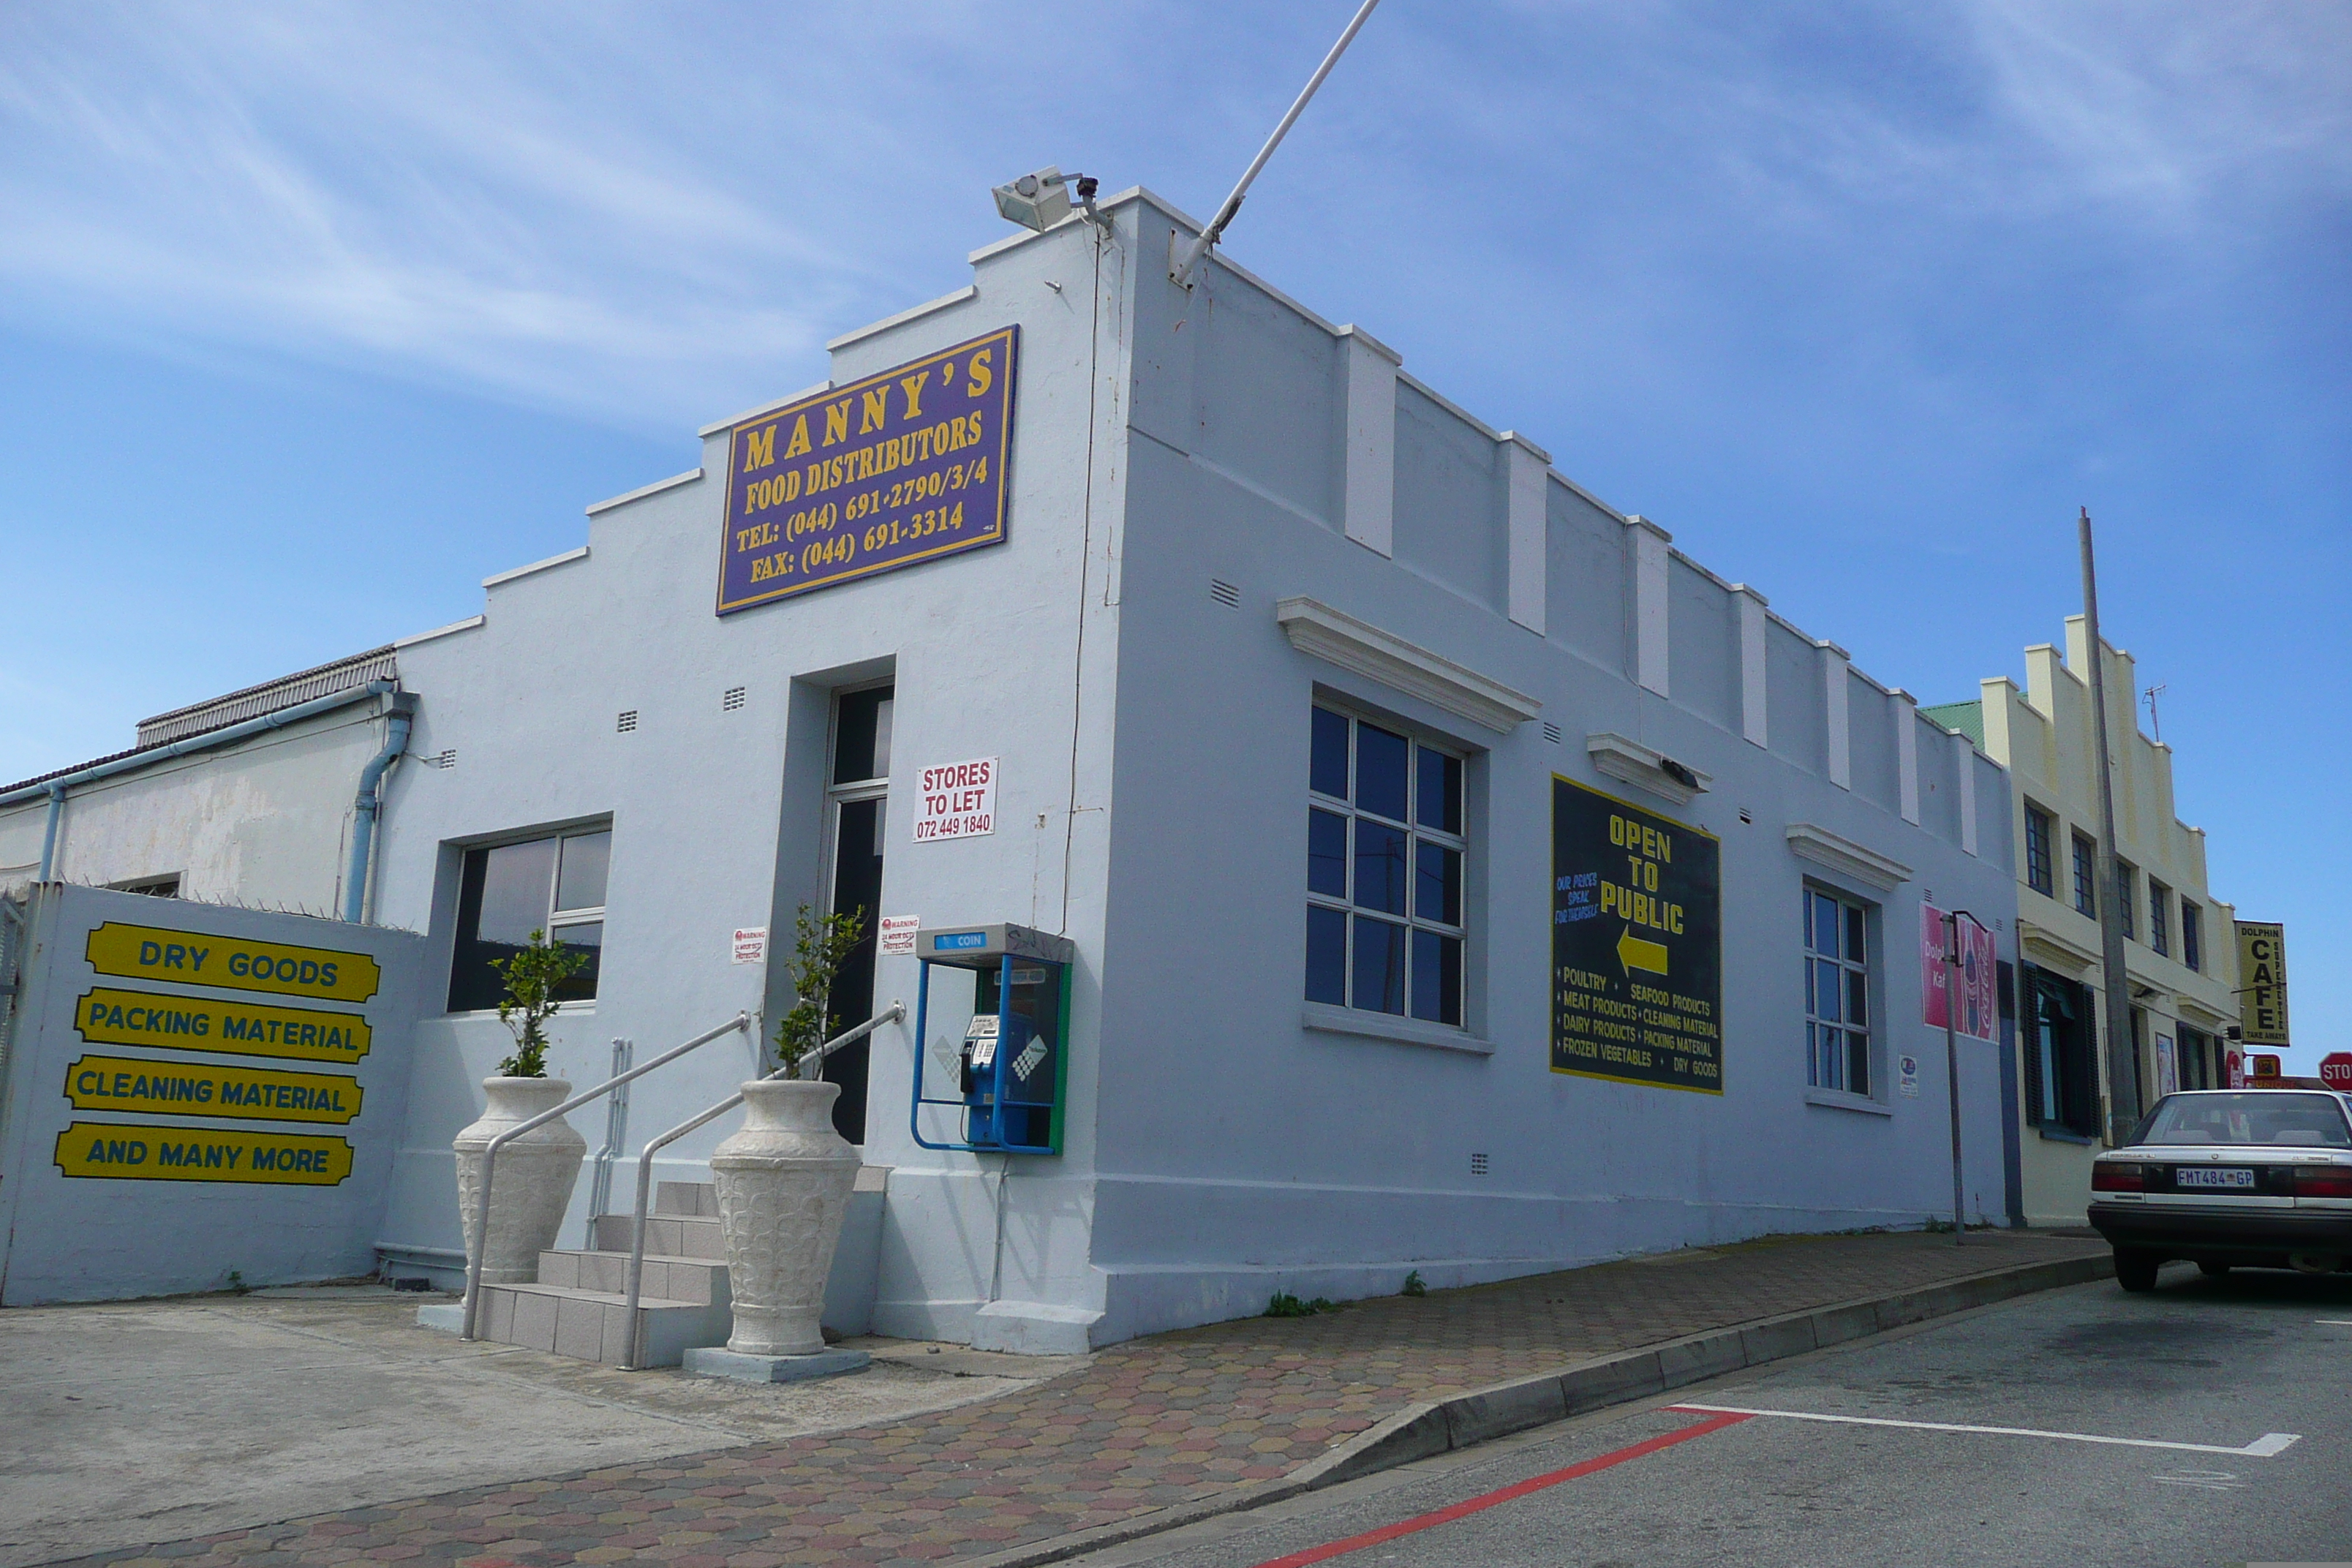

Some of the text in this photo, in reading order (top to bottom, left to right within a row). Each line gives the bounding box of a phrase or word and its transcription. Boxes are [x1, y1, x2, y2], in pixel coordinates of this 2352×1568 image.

[743, 348, 992, 472] MANNY'S
[745, 410, 981, 514] FOOD DISTRIBUTORS
[736, 456, 987, 552] TEL: (044) 691-2790/3/4
[750, 502, 962, 583] FAX: (044) 691-3314
[923, 761, 990, 791] STORES
[925, 789, 985, 815] TO LET
[917, 814, 990, 838] 072 449 1840
[1610, 814, 1671, 863] OPEN
[1557, 872, 1597, 891] OUR PRICES
[1628, 855, 1658, 892] TO
[1568, 890, 1589, 905] SPEAK
[1601, 880, 1684, 935] PUBLIC
[892, 919, 918, 928] WARNING
[2242, 928, 2279, 938] DOLPHIN
[883, 942, 913, 950] PROTECTION
[957, 935, 981, 946] COIN
[1925, 942, 1947, 963] Dolp
[139, 941, 338, 987] DRY GOODS
[1564, 966, 1607, 992] POULTRY
[1933, 971, 1946, 987] Kaf
[2251, 940, 2274, 1029] CAFE
[1564, 990, 1637, 1021] MEAT PRODUCTS
[1630, 984, 1710, 1017] SEAFOOD PRODUCTS
[89, 1003, 358, 1050] PACKING MATERIAL
[1564, 1014, 1636, 1043] DAIRY PRODUCTS
[1643, 1008, 1718, 1039] CLEANING MATERIAL
[2247, 1031, 2286, 1040] TAKE AWAYS
[1563, 1037, 1652, 1068] FROZEN VEGETABLES
[1643, 1030, 1712, 1058] PACKING MATERIAL
[1674, 1057, 1718, 1078] DRY GOODS
[2323, 1064, 2352, 1079] STO
[77, 1071, 346, 1112] CLEANING MATERIAL
[86, 1139, 329, 1172] AND MANY MORE
[2178, 1171, 2253, 1186] FMT484 GP
